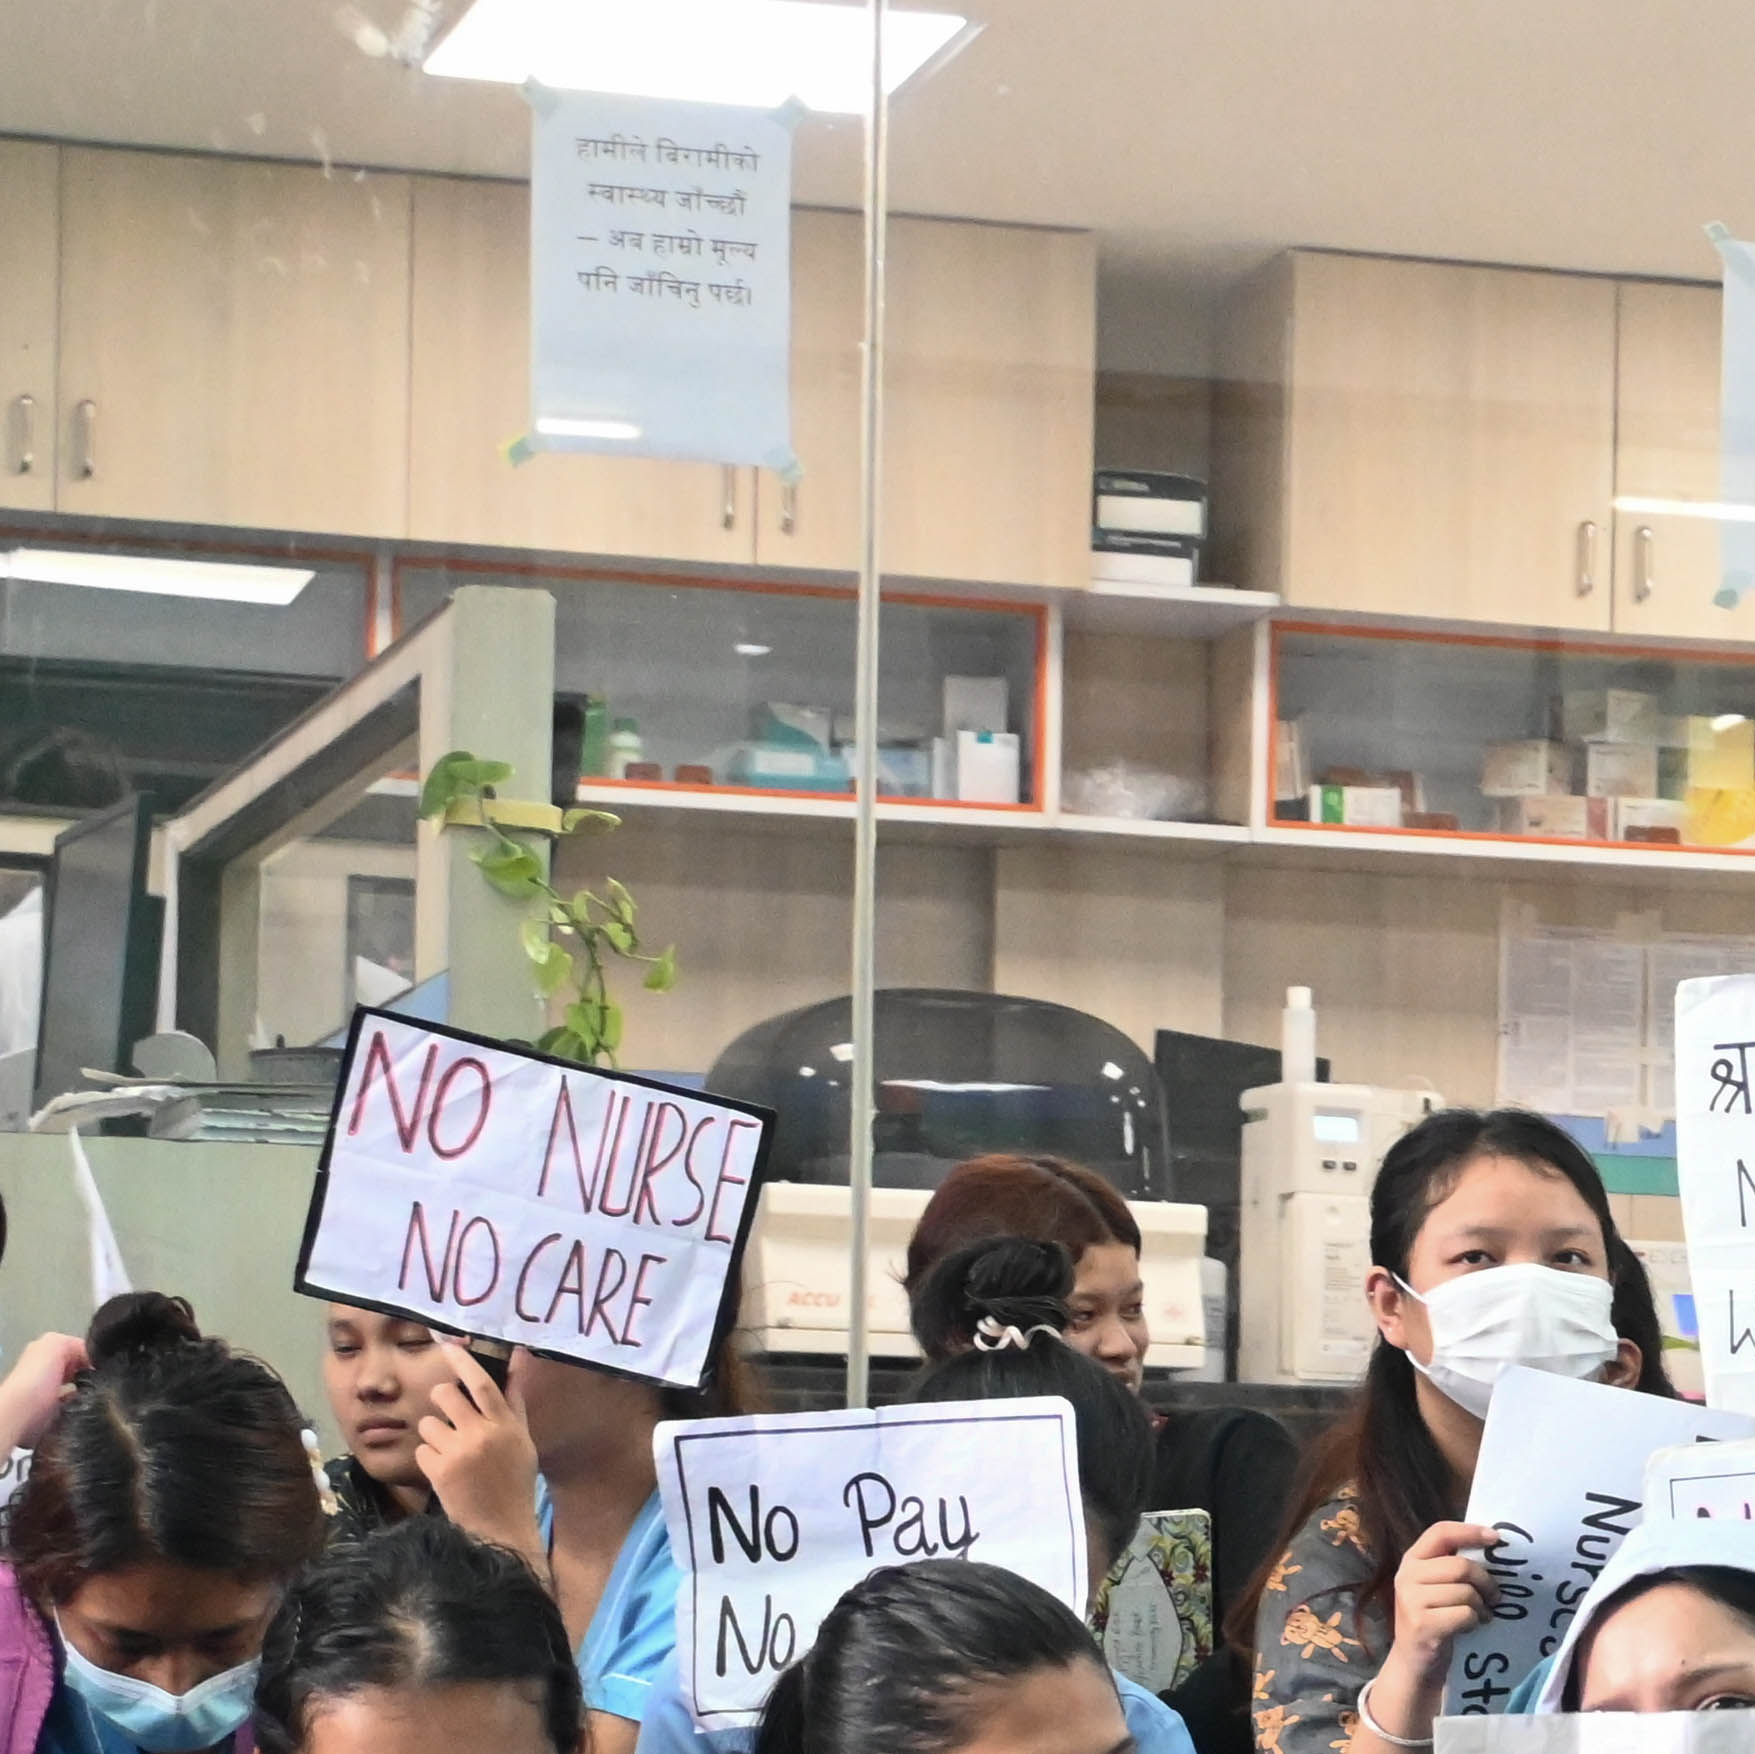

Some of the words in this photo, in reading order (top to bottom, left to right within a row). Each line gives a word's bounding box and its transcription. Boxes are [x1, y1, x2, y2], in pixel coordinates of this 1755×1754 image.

[576, 134, 648, 162] हामीले
[577, 265, 618, 292] पनि
[609, 229, 645, 251] अब
[652, 228, 704, 259] हाम्रो
[711, 238, 759, 266] मूल्य
[347, 1030, 493, 1161] NO
[536, 1073, 761, 1245] NURSE
[398, 1200, 500, 1308] NO
[514, 1231, 669, 1349] CARE
[707, 1484, 800, 1565] No
[842, 1471, 982, 1561] Pay
[714, 1593, 797, 1679] No
